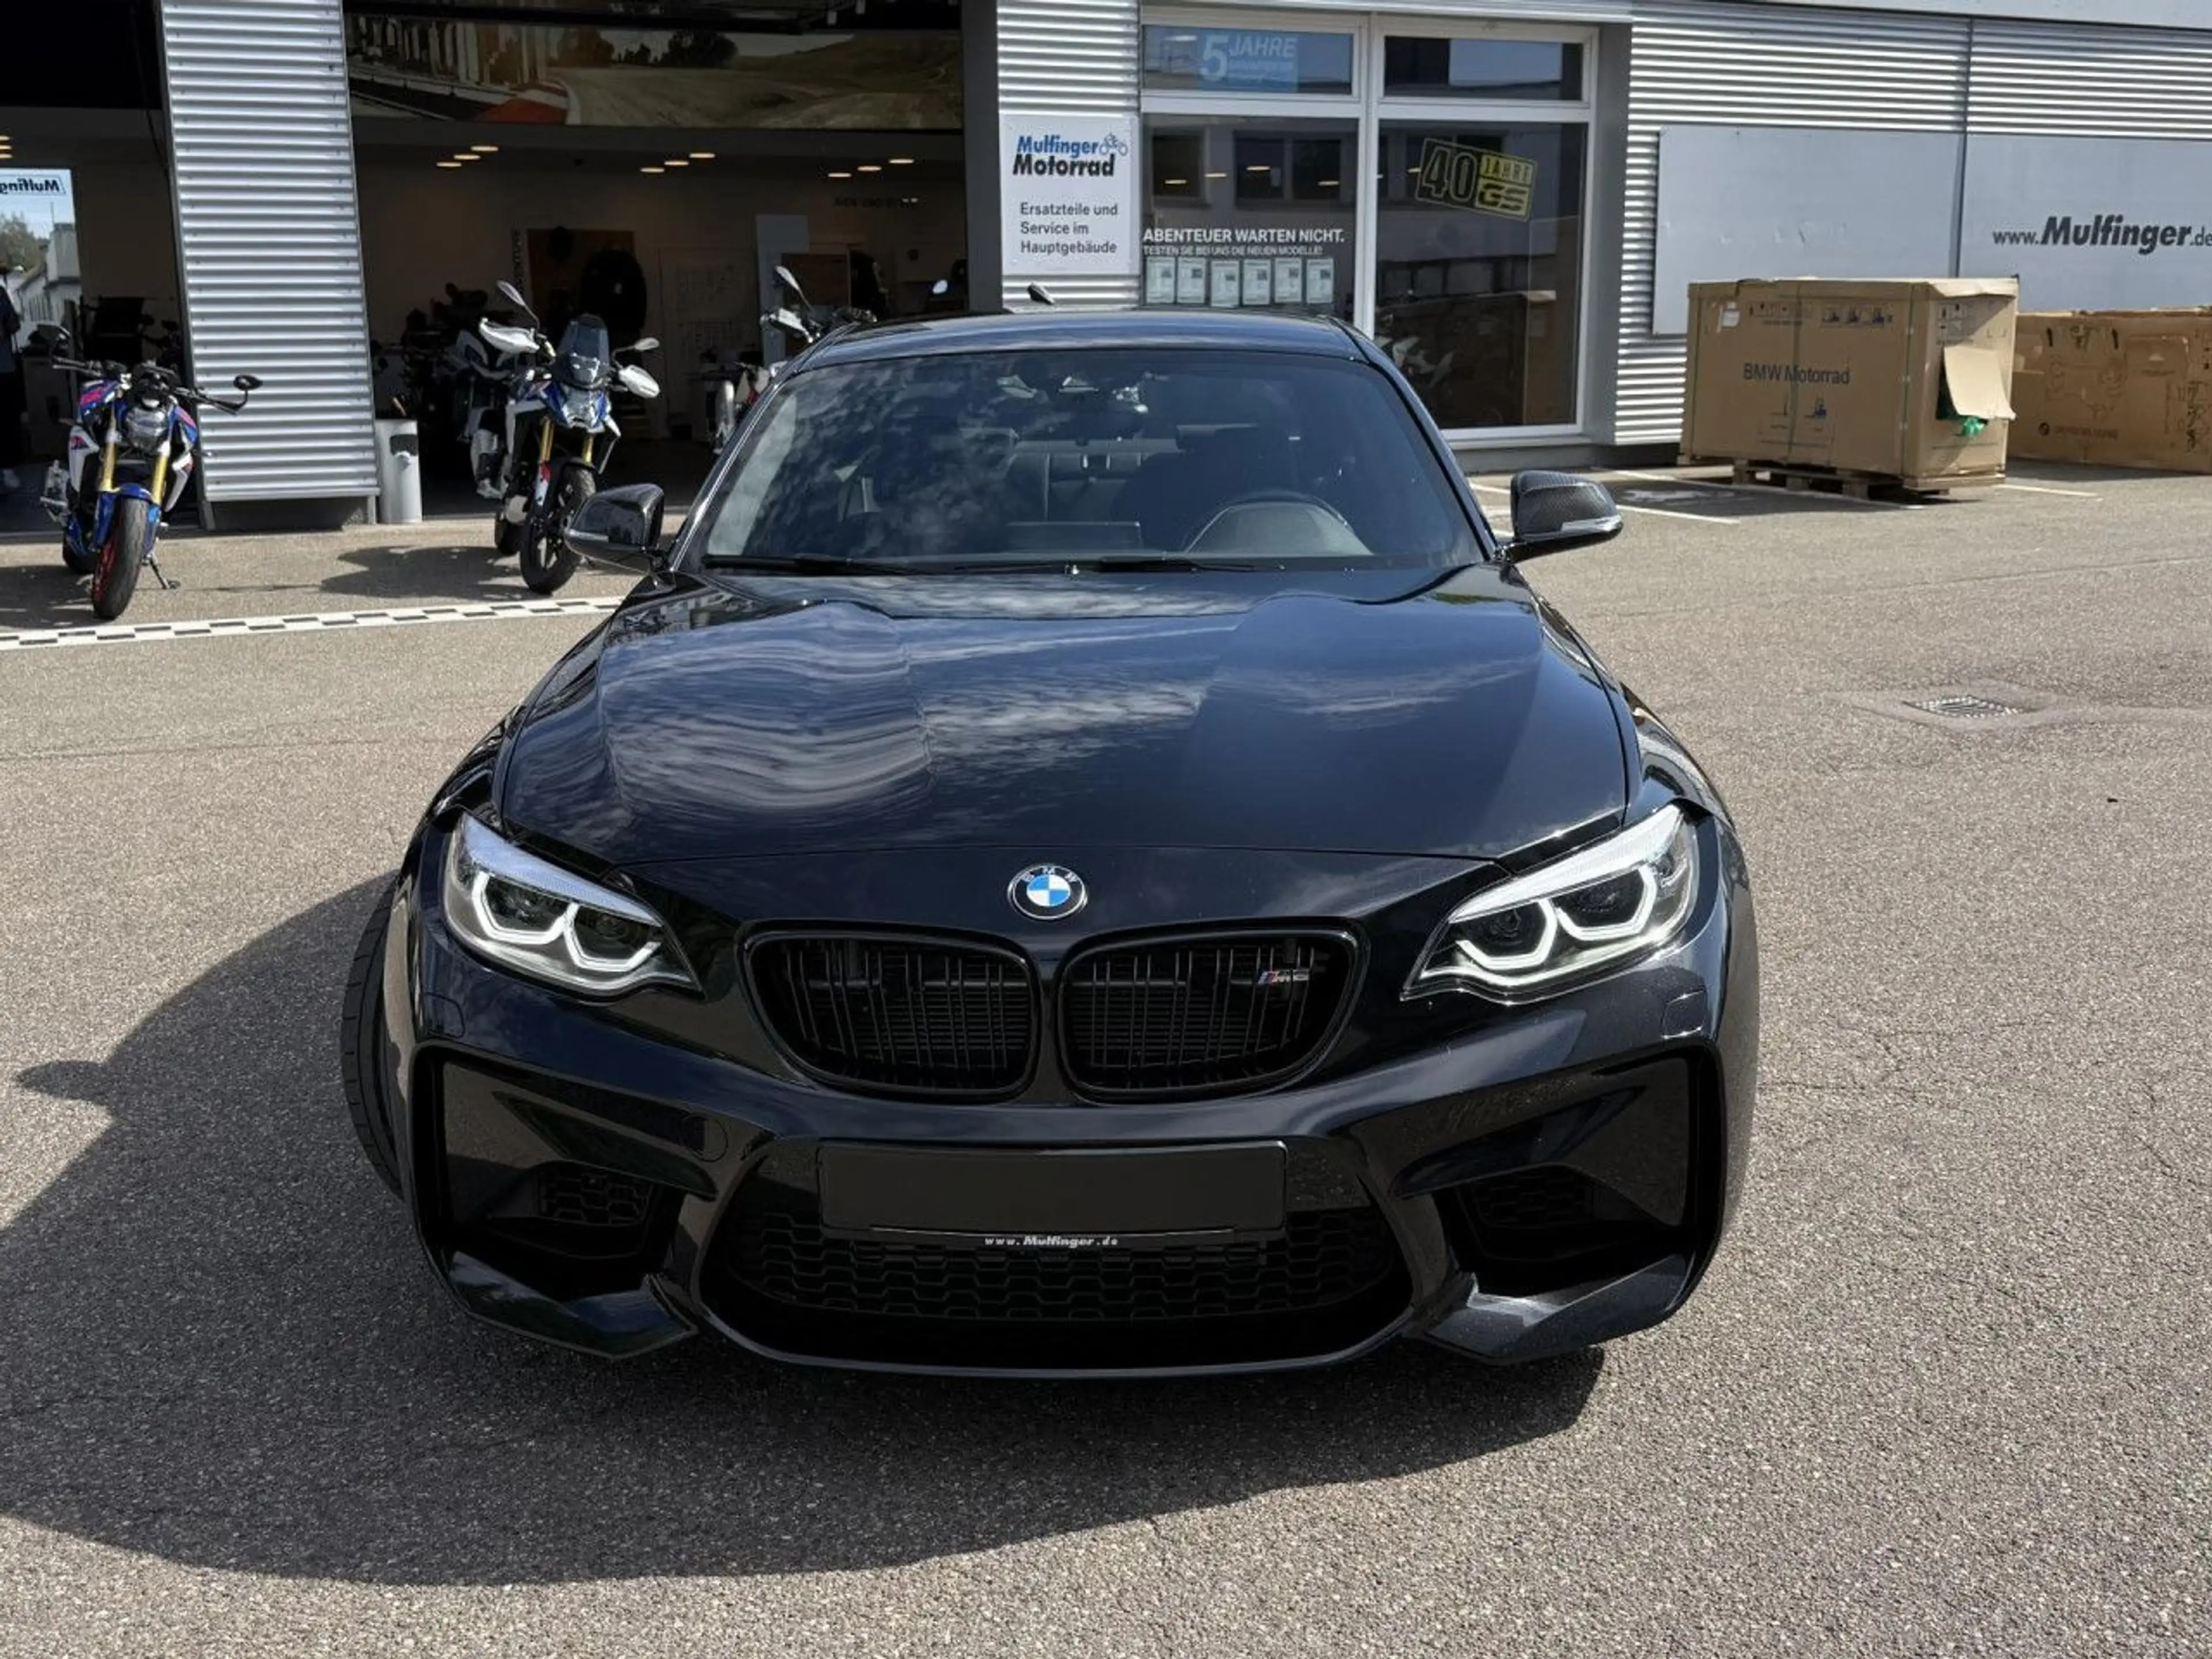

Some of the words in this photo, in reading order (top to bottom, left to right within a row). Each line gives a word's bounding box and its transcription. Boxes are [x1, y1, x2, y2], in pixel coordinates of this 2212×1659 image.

[1200, 35, 1229, 81] 5
[1229, 36, 1297, 58] JAHRE
[1017, 135, 1099, 158] Mulfinger
[1013, 154, 1115, 176] Motorrad
[1021, 202, 1090, 215] Ersatzteile
[1094, 204, 1118, 215] und
[1021, 221, 1070, 234] Service
[1073, 222, 1089, 234] im
[1143, 229, 1232, 243] ABENTEUER
[1235, 229, 1296, 243] WARTEN
[1298, 229, 1345, 243] NICHT.
[1021, 241, 1118, 256] Hauptgebäude
[1743, 362, 1782, 381] BMW
[1785, 365, 1851, 384] Motorrad
